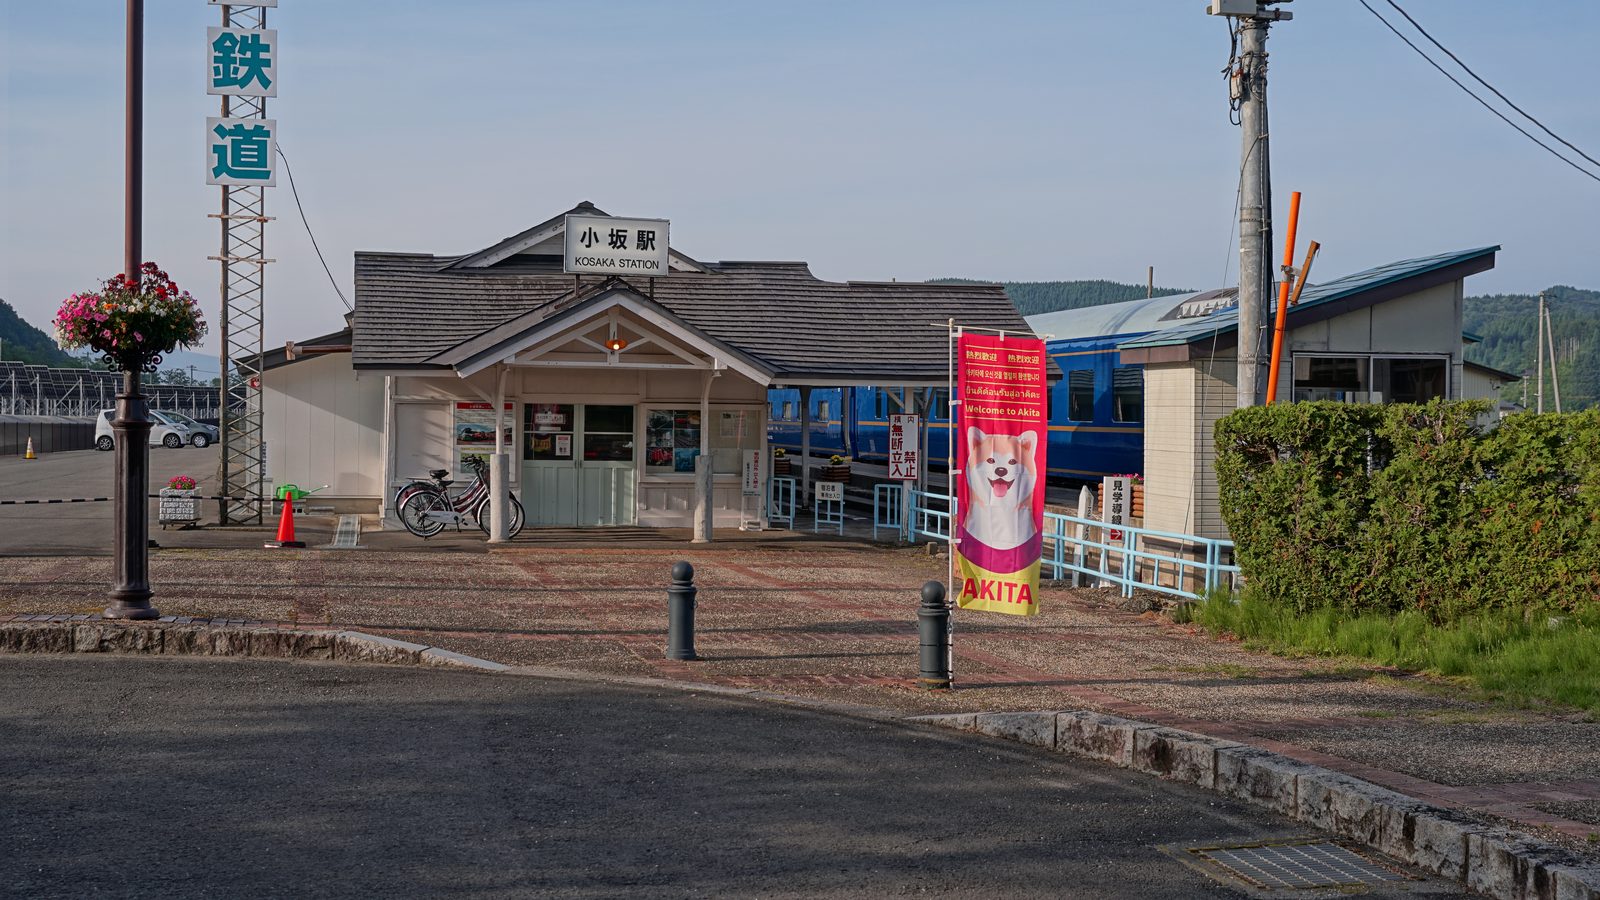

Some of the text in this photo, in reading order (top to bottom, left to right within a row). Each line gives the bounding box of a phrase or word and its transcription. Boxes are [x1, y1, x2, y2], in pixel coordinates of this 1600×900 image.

[212, 32, 272, 180] 鉄道
[580, 227, 656, 251] 小坂駅
[574, 257, 659, 269] KOSAKA STATION
[965, 404, 1040, 417] Welcome to Akita
[891, 424, 916, 477] 無断立入 禁止
[1112, 481, 1123, 525] 見学導線
[963, 578, 1033, 605] AKITA
